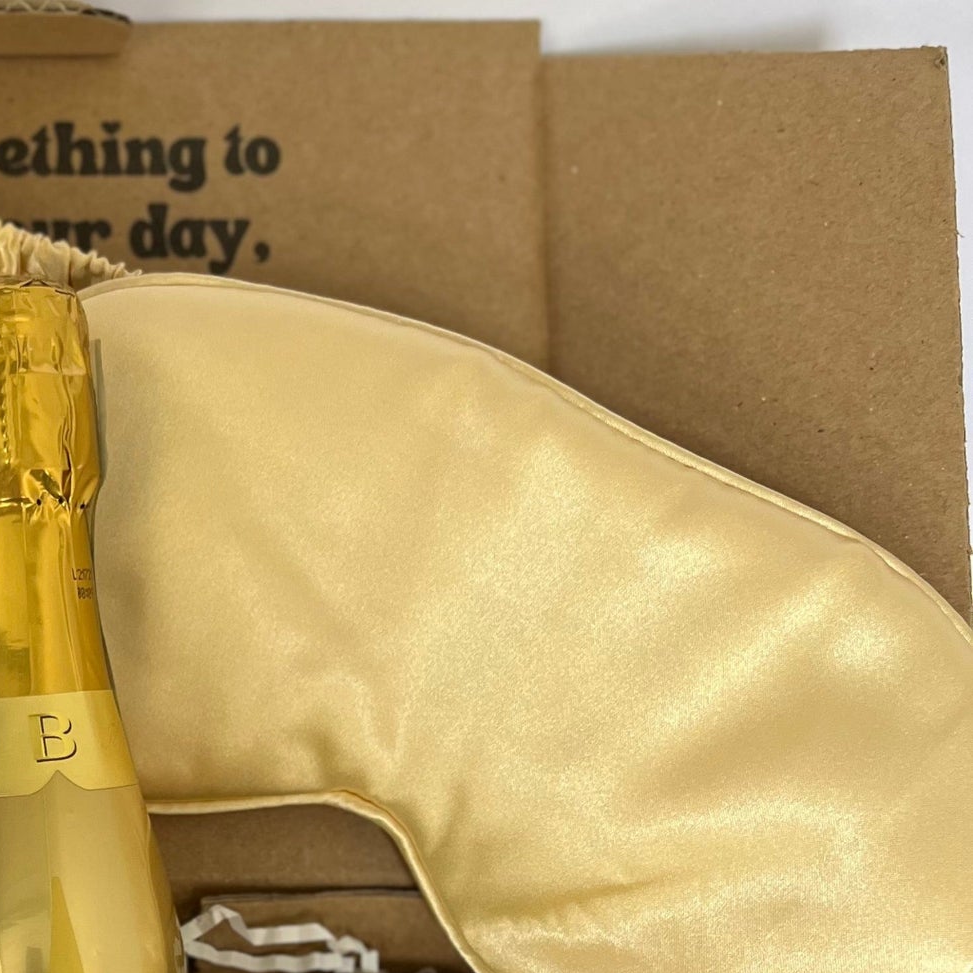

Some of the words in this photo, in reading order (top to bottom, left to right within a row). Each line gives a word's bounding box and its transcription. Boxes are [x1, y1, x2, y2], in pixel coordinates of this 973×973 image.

[223, 126, 281, 177] to
[129, 204, 271, 276] day,
[29, 713, 77, 763] B
